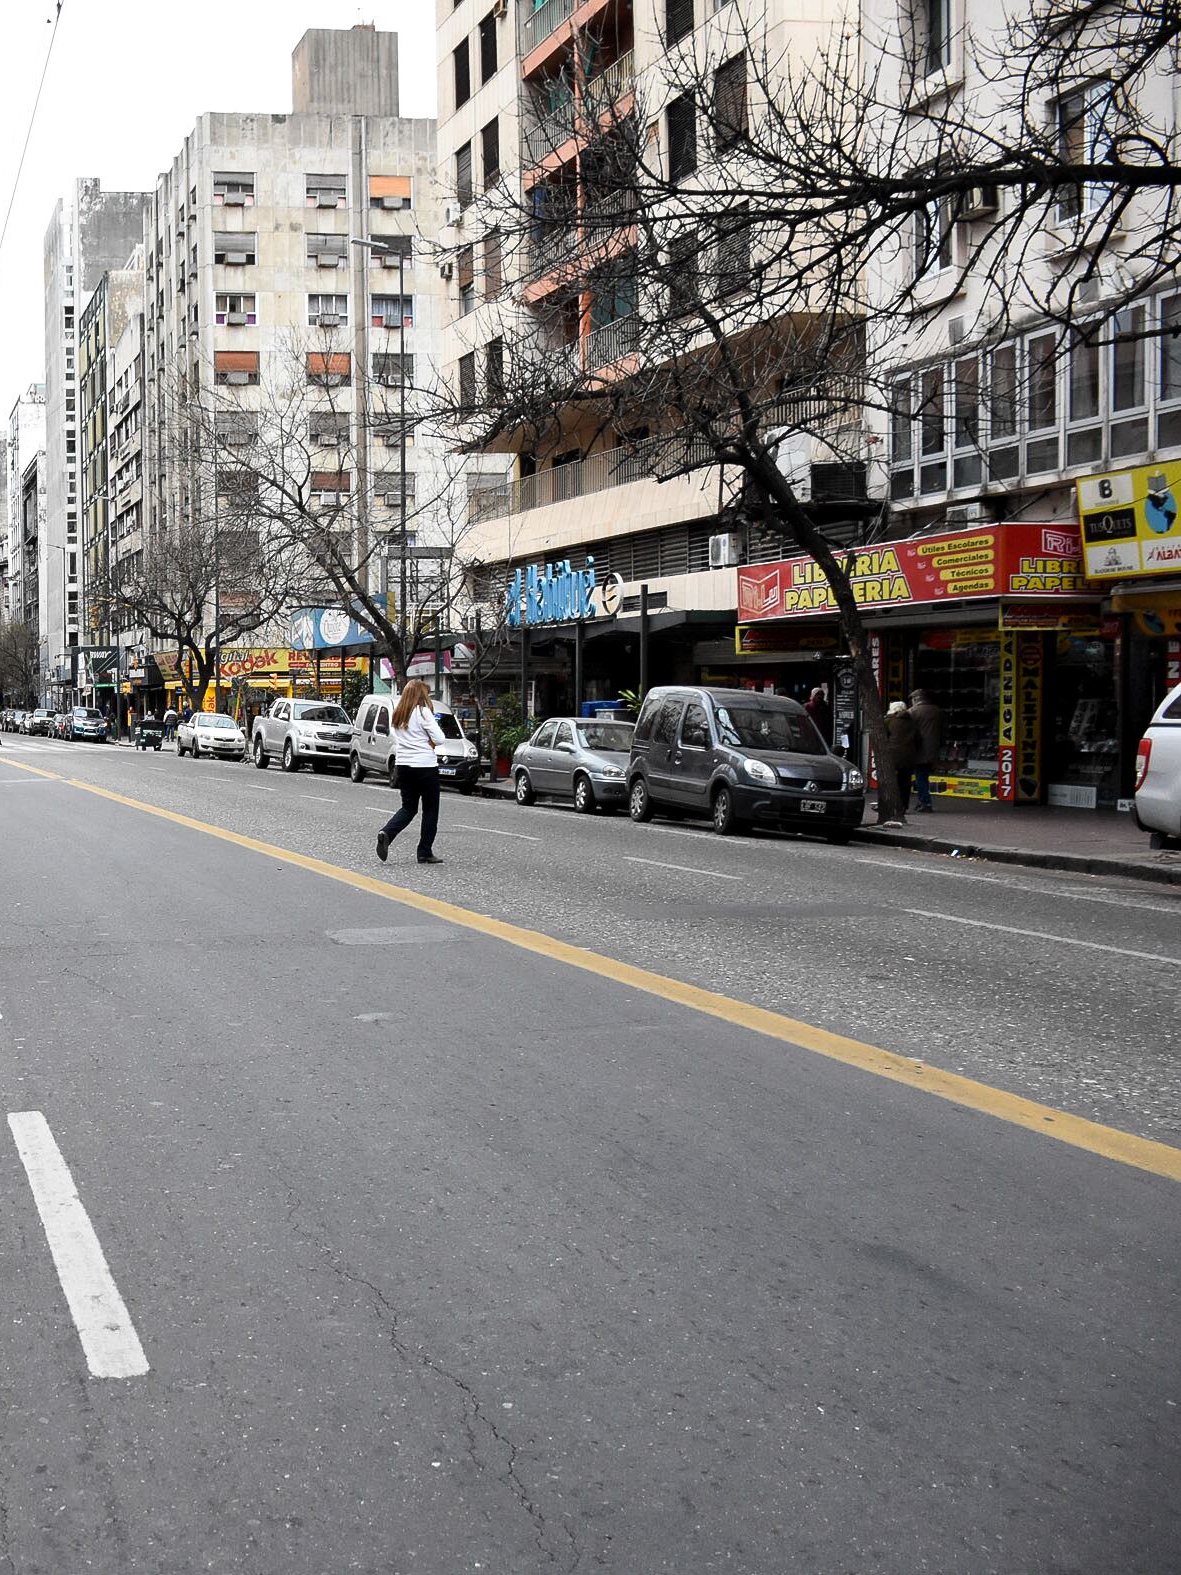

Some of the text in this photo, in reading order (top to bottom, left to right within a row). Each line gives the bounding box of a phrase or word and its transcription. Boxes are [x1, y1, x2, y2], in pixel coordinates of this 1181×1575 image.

[1099, 479, 1112, 498] B
[947, 538, 990, 551] Escolares
[936, 553, 990, 566] Comerciales
[950, 567, 990, 578] Técnicos
[952, 582, 990, 593] Agendas
[1001, 749, 1013, 797] 2017
